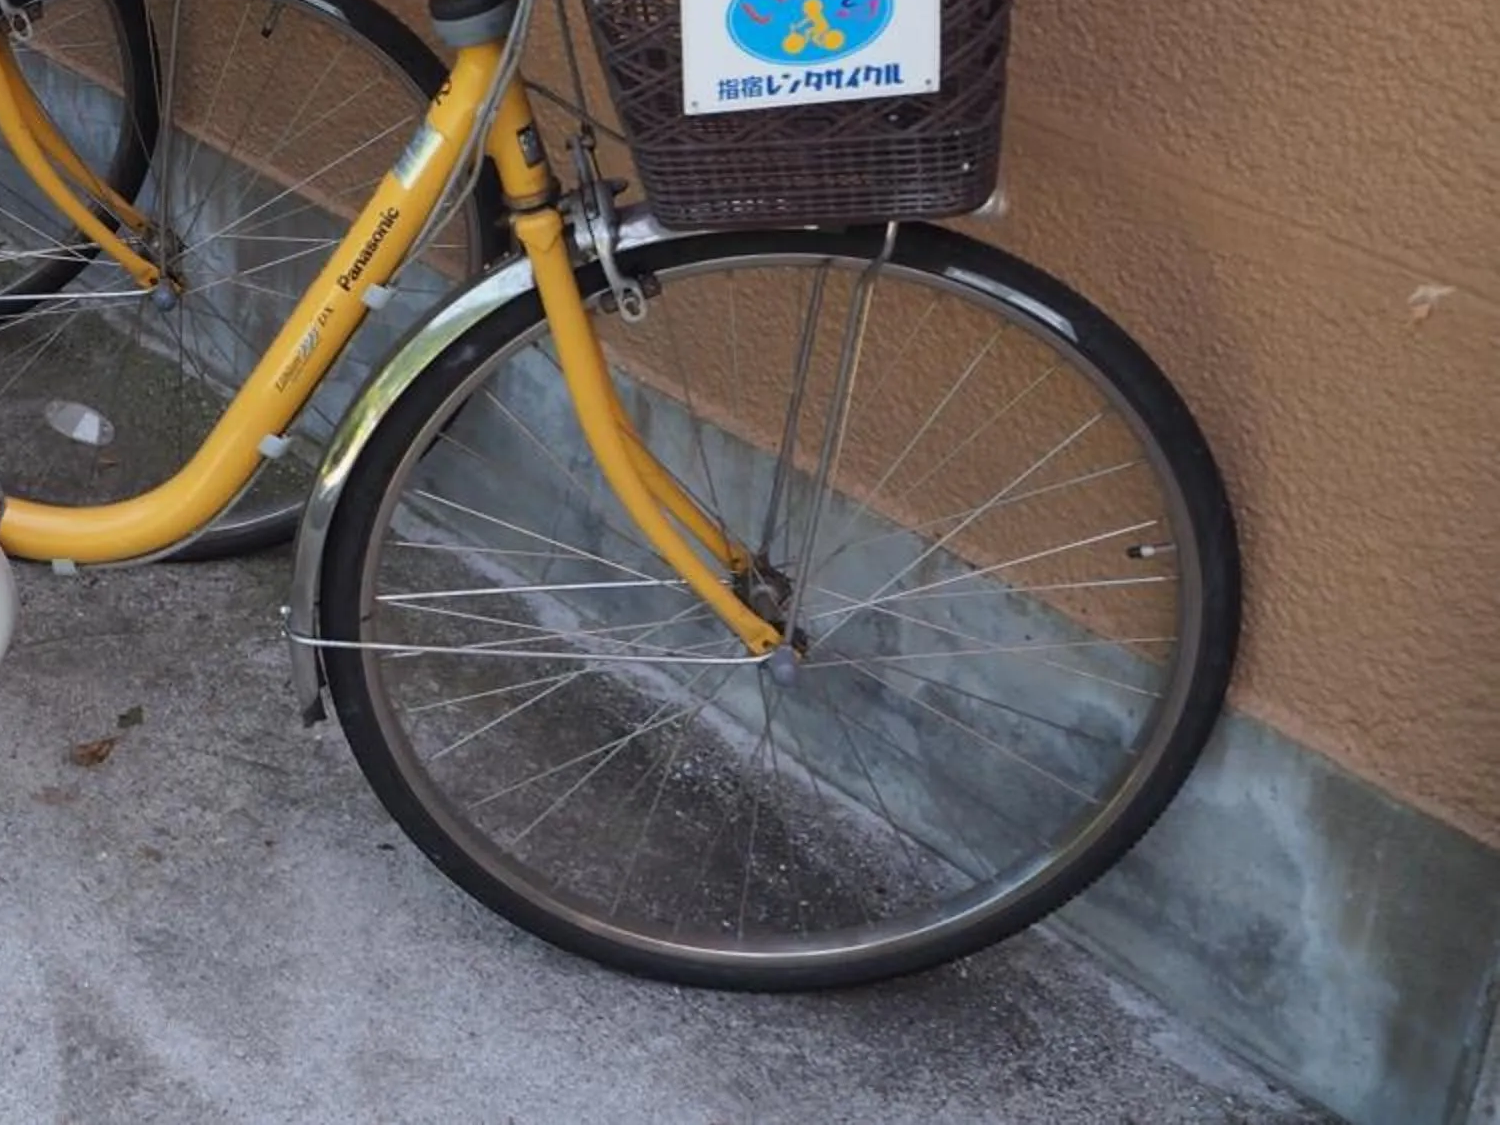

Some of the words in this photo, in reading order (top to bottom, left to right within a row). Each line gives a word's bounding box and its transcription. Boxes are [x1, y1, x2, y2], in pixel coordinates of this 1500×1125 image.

[717, 63, 904, 101] 指宿レンタサイクル
[336, 206, 400, 292] Panasonic
